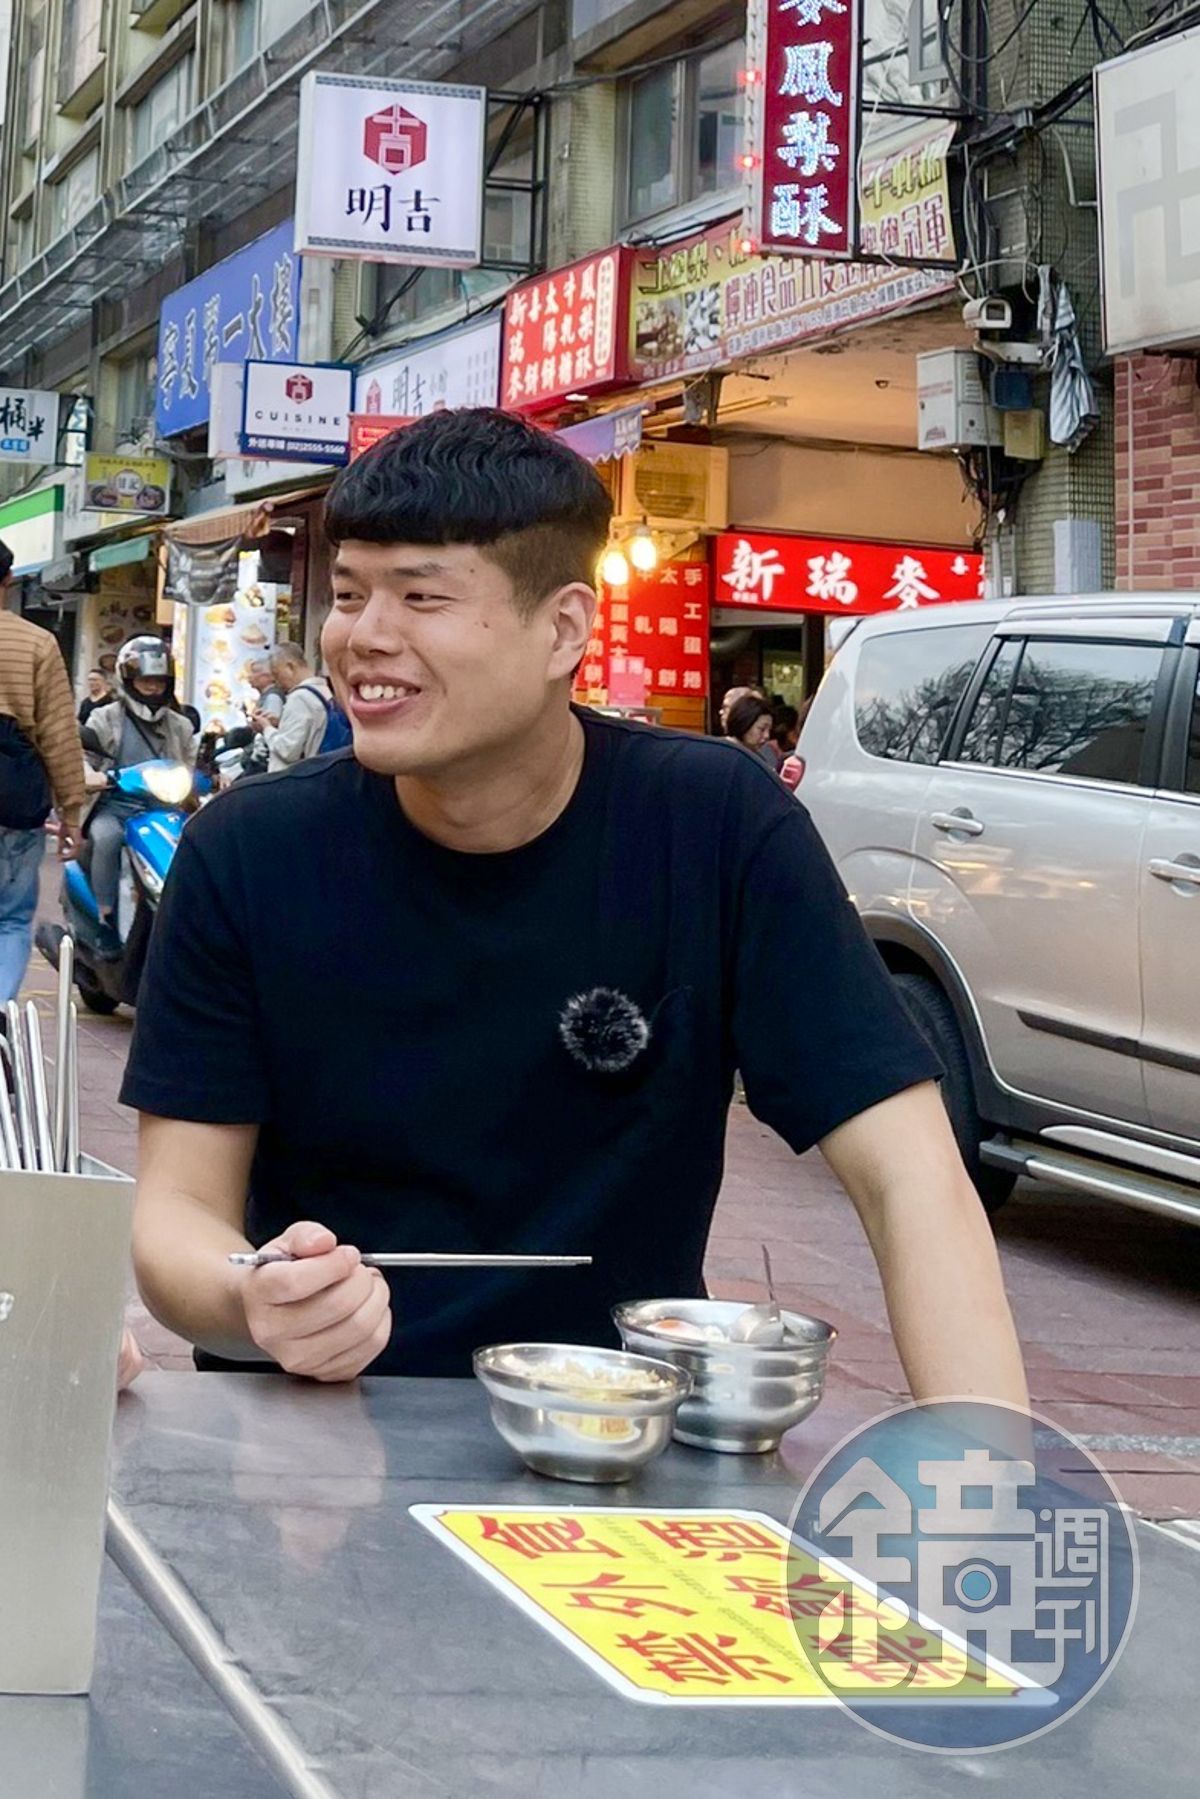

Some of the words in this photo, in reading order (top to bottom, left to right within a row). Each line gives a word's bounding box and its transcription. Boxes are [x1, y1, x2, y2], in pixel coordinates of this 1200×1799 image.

[346, 184, 441, 232] 明吉
[507, 292, 528, 403] 新瑞麥
[255, 410, 341, 426] CUISINE
[721, 539, 940, 610] 新瑞麥
[475, 1514, 794, 1686] 禁外食
